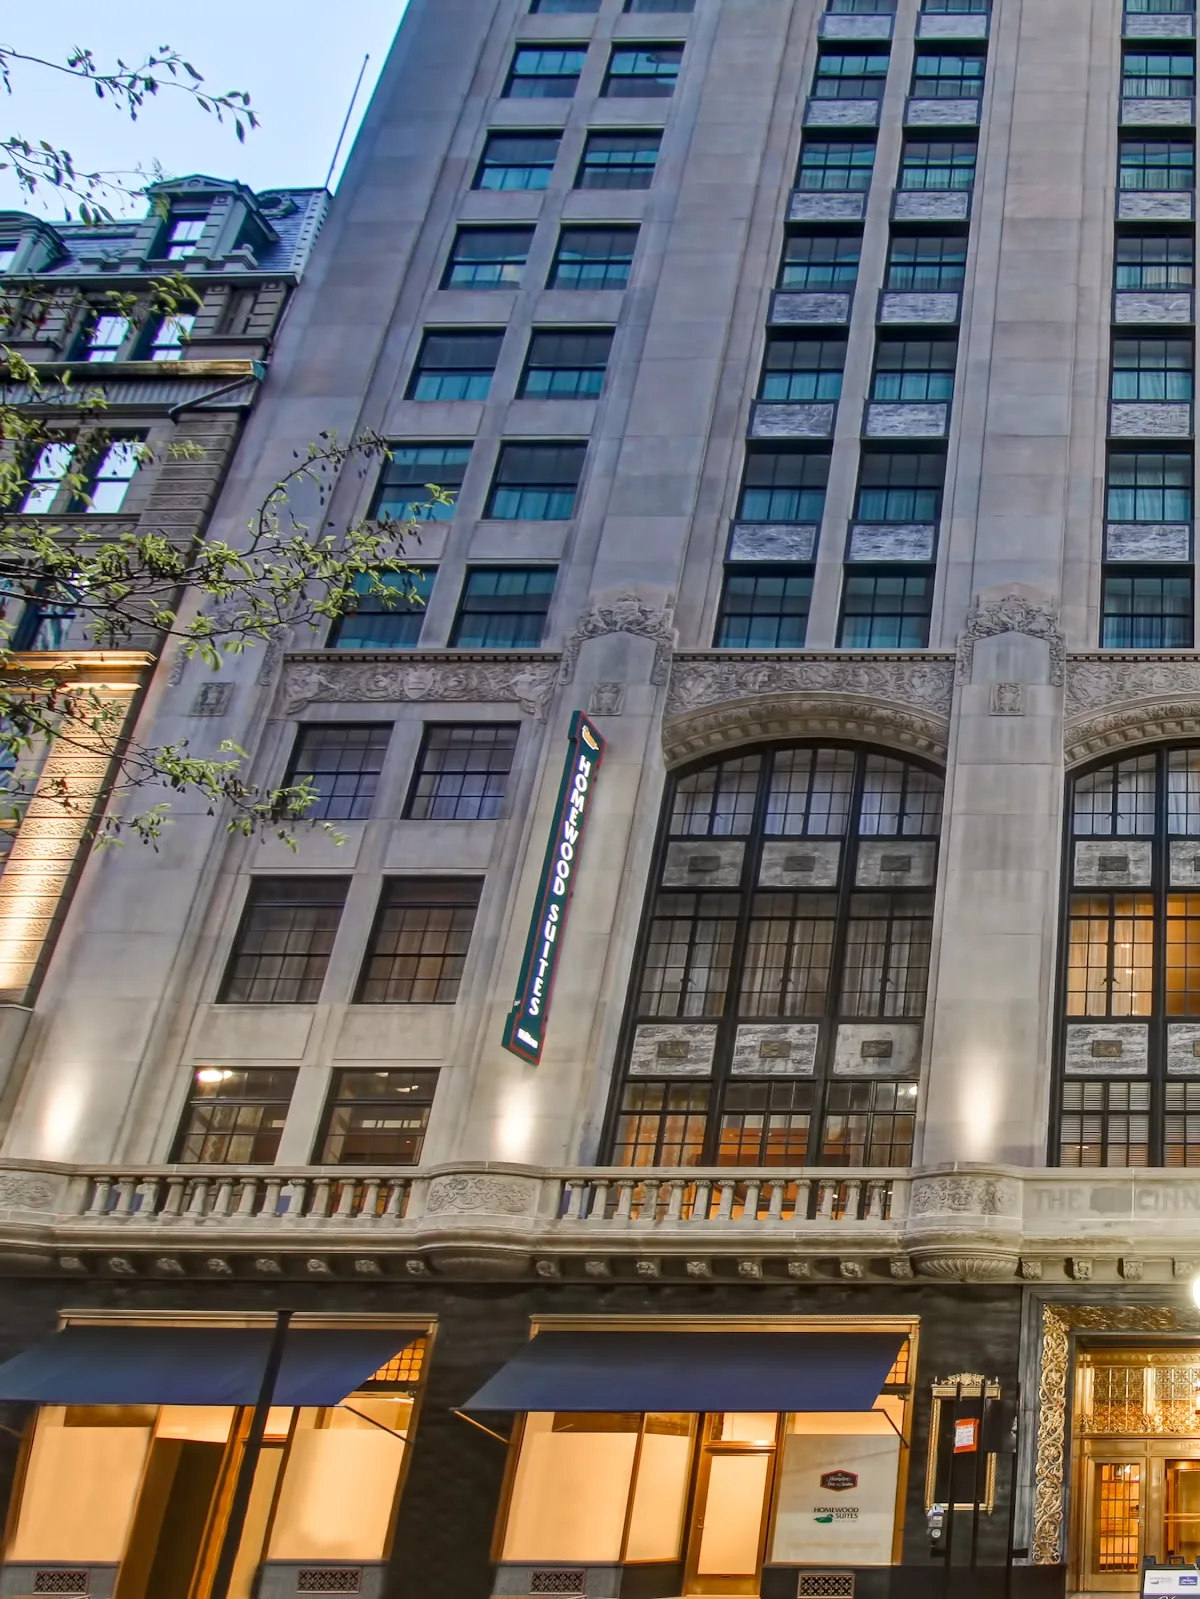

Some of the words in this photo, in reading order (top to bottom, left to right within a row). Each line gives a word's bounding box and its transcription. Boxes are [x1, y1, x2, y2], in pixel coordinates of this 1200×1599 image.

[553, 754, 592, 897] HOMEWOOD
[528, 903, 560, 1017] SUITES
[1032, 1188, 1082, 1213] THE
